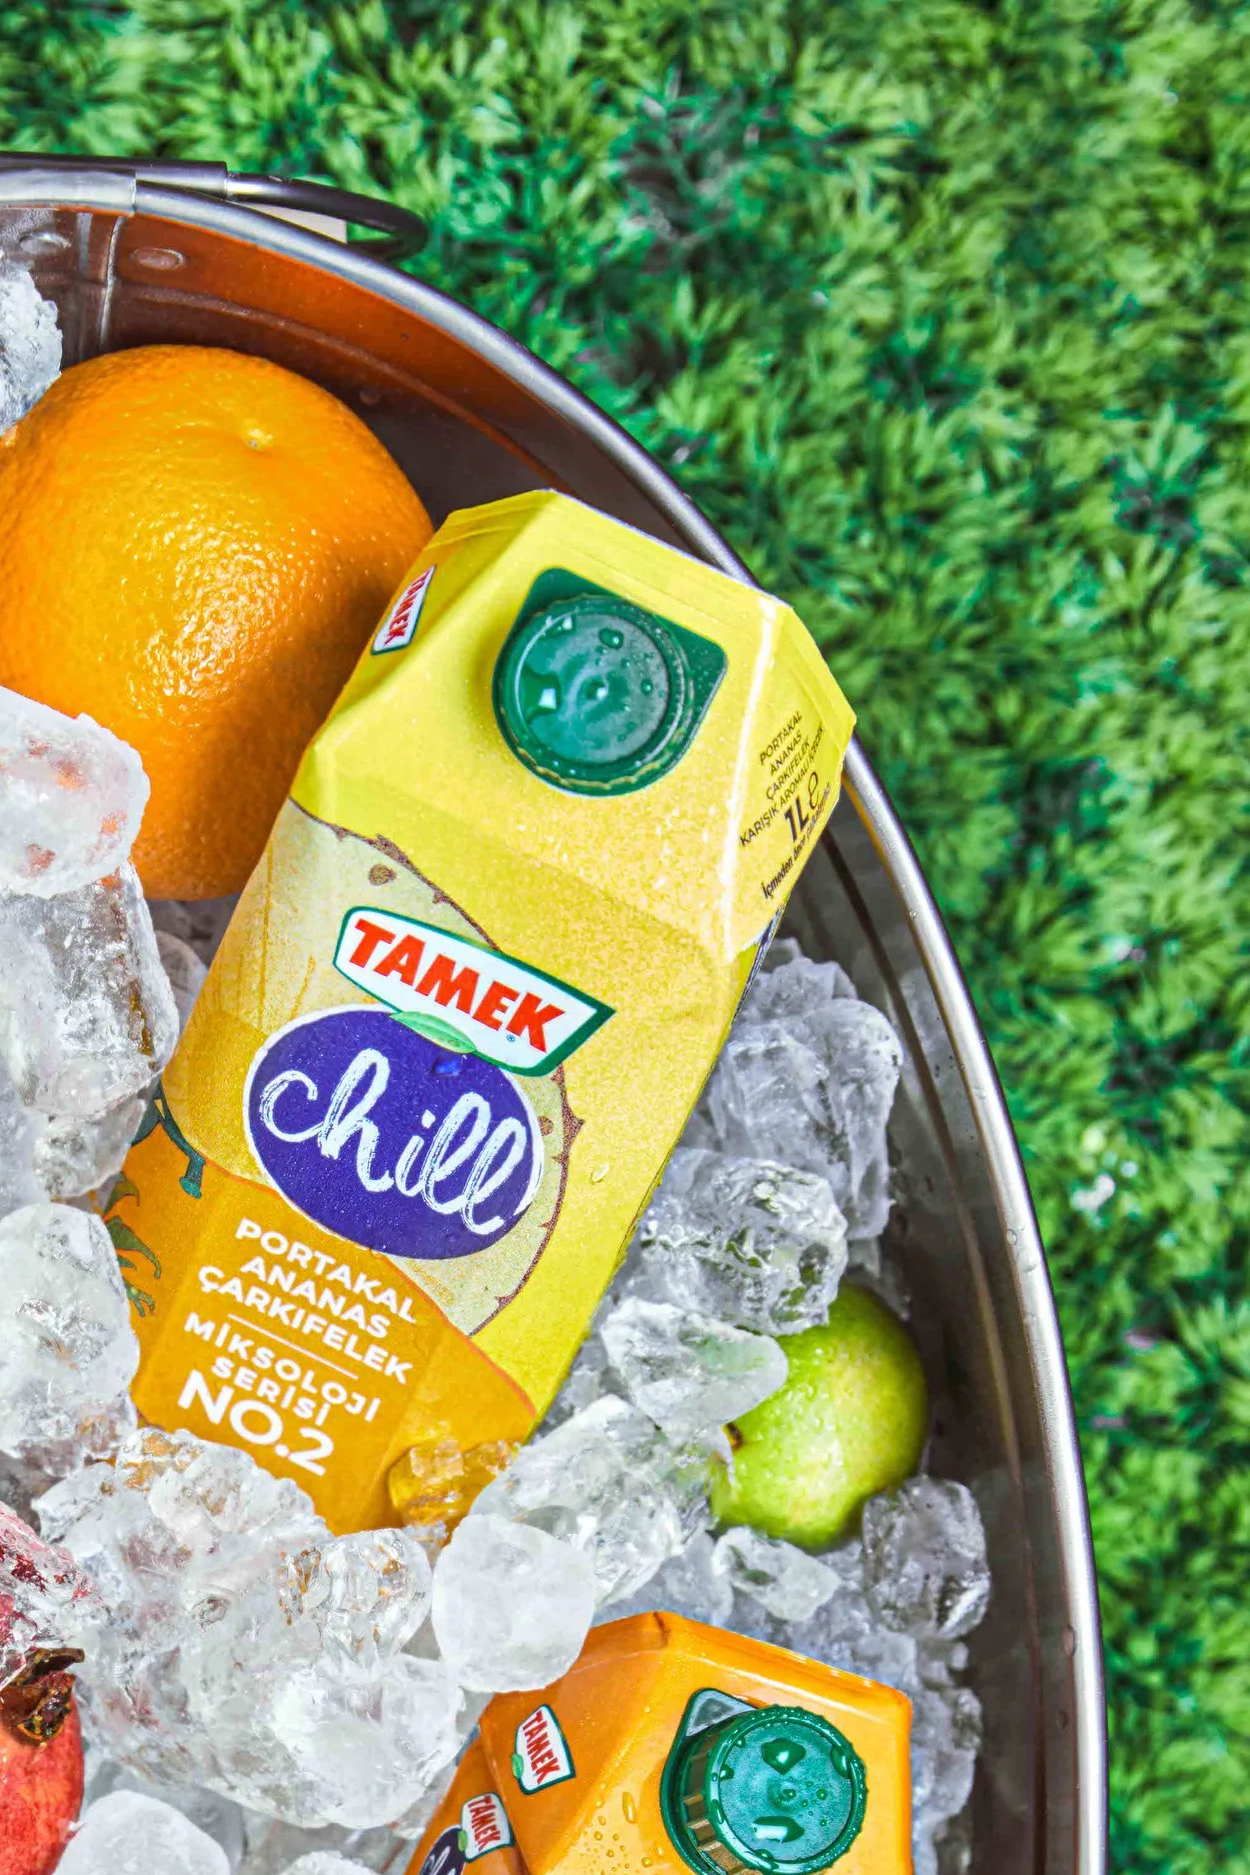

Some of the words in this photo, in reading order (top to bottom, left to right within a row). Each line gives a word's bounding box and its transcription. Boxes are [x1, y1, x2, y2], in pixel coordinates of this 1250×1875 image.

[759, 711, 803, 767] PORTAKAL
[770, 729, 803, 776] ANANAS
[739, 802, 780, 847] KARIŞIK
[349, 918, 566, 1053] TAMEK
[259, 1048, 527, 1235] chill
[235, 1217, 417, 1324] PORTAKAL
[240, 1255, 392, 1339] ANANAS
[198, 1265, 413, 1384] ÇARKIFELEK
[184, 1312, 381, 1423] MİKSOLOJİ
[211, 1356, 333, 1427] SERİSİ
[177, 1369, 335, 1477] NO.2
[522, 1710, 561, 1785] TAMEK
[468, 1795, 501, 1852] TAMEK
